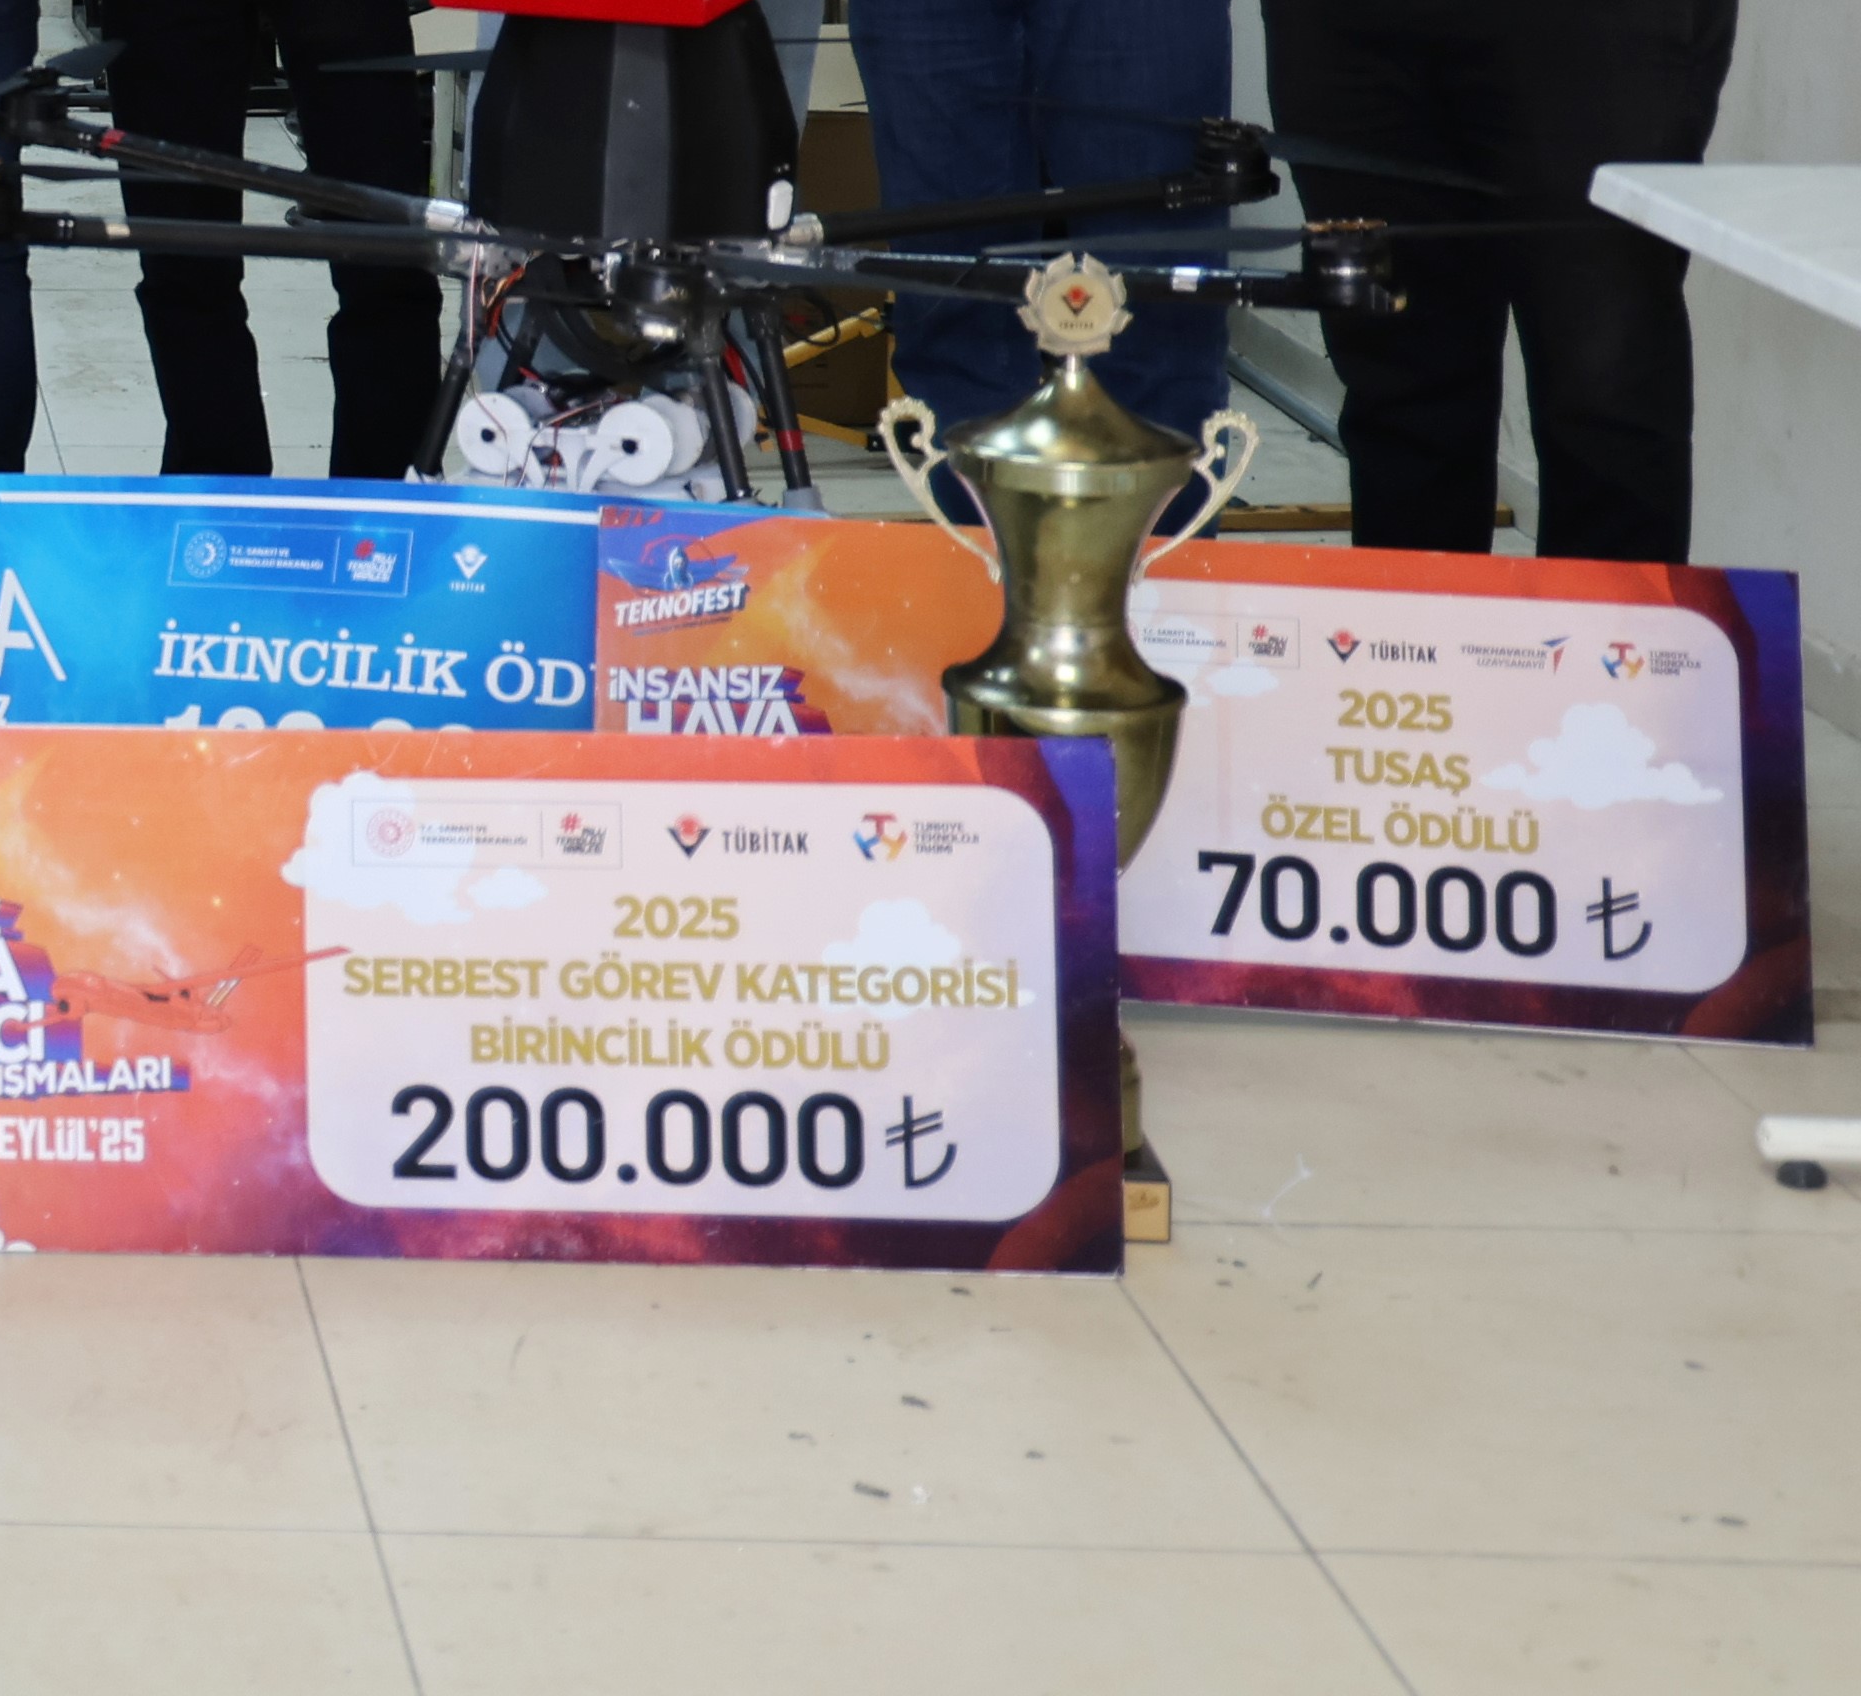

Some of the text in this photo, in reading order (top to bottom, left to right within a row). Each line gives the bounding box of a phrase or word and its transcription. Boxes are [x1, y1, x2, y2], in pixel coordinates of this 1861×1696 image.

[614, 582, 748, 628] TEKNOFEST
[154, 618, 597, 707] İKİNCİLİK ÖD
[1369, 641, 1439, 666] TÜBİTAK
[609, 664, 786, 701] İNSANSIZ
[1337, 689, 1453, 733] 2025
[1325, 747, 1472, 797] TUSAŞ
[721, 826, 809, 855] TÜBİTAK
[1260, 794, 1540, 855] ÖZEL ÖDÜLÜ
[613, 895, 741, 941] 2025
[1197, 850, 1558, 958] 70.000
[343, 950, 1019, 1009] SERBEST GÖREV KATEGORİSİ
[469, 1015, 891, 1072] BİRİNCİLİK ÖDÜLÜ
[389, 1083, 866, 1190] 200.000
